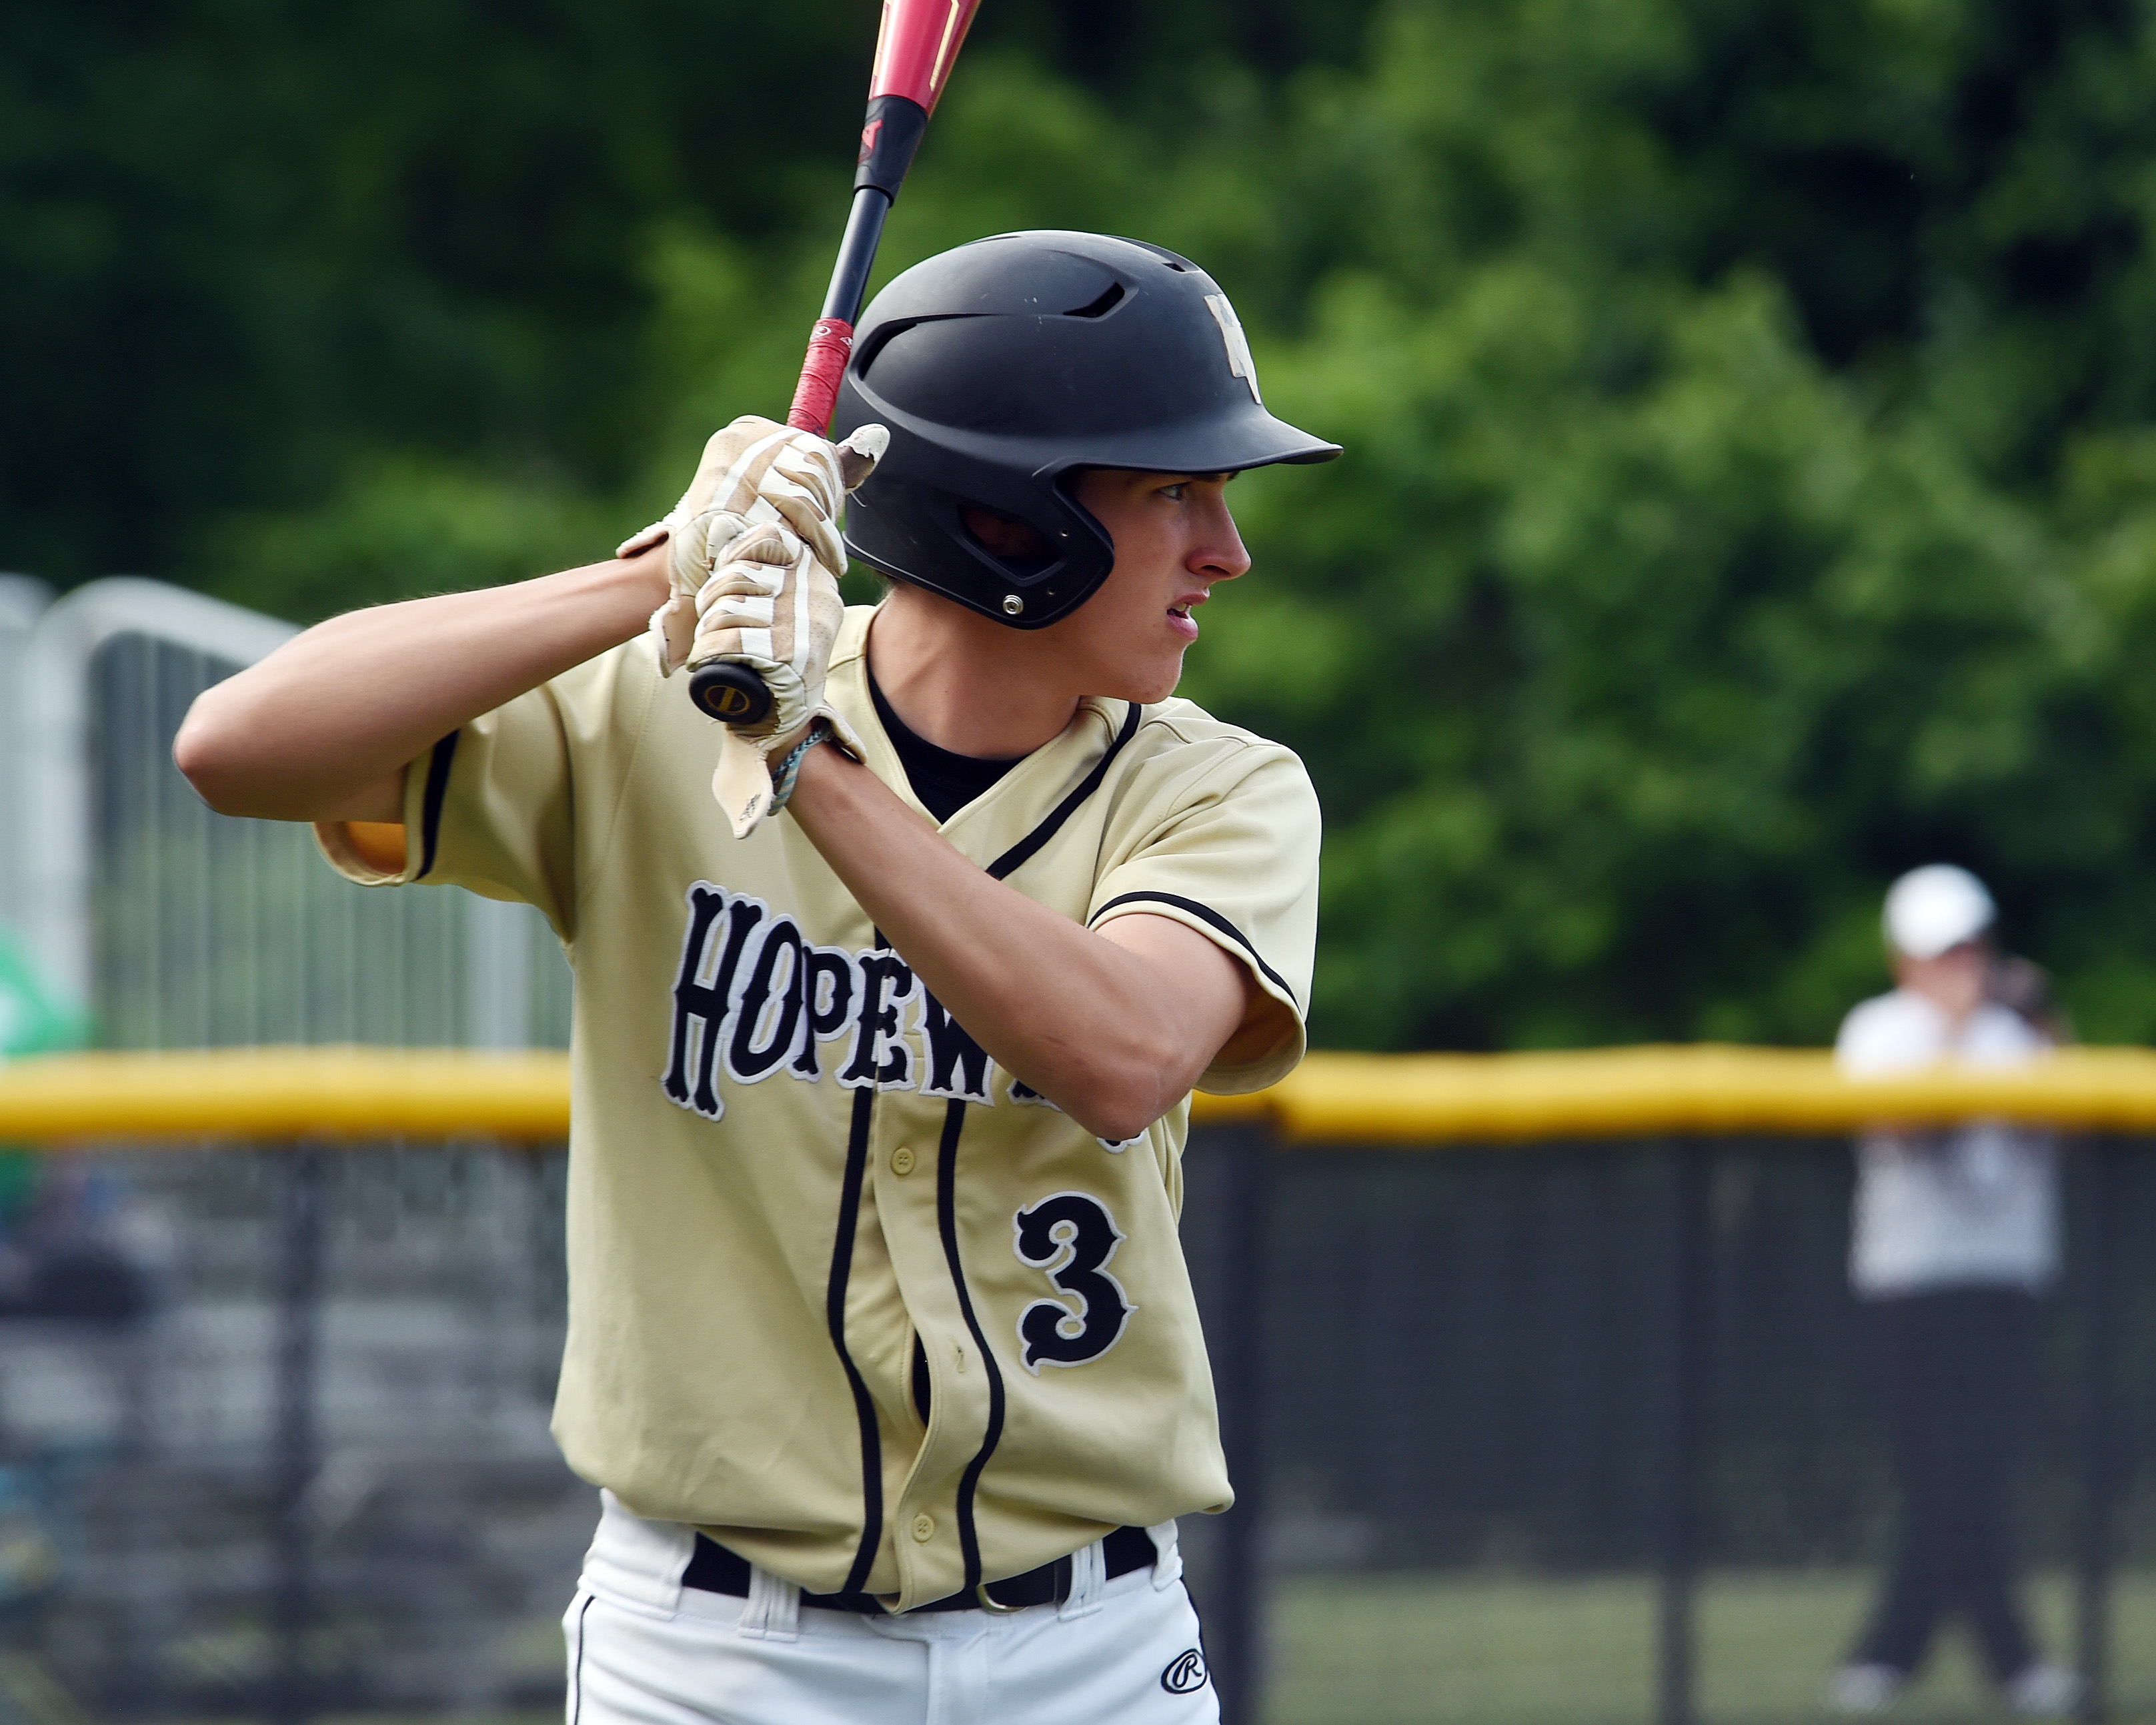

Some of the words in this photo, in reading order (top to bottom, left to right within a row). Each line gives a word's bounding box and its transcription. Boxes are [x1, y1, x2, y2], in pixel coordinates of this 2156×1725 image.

[661, 879, 1150, 1155] HOPEW
[1012, 1190, 1139, 1377] 3
[1171, 1652, 1203, 1689] R
